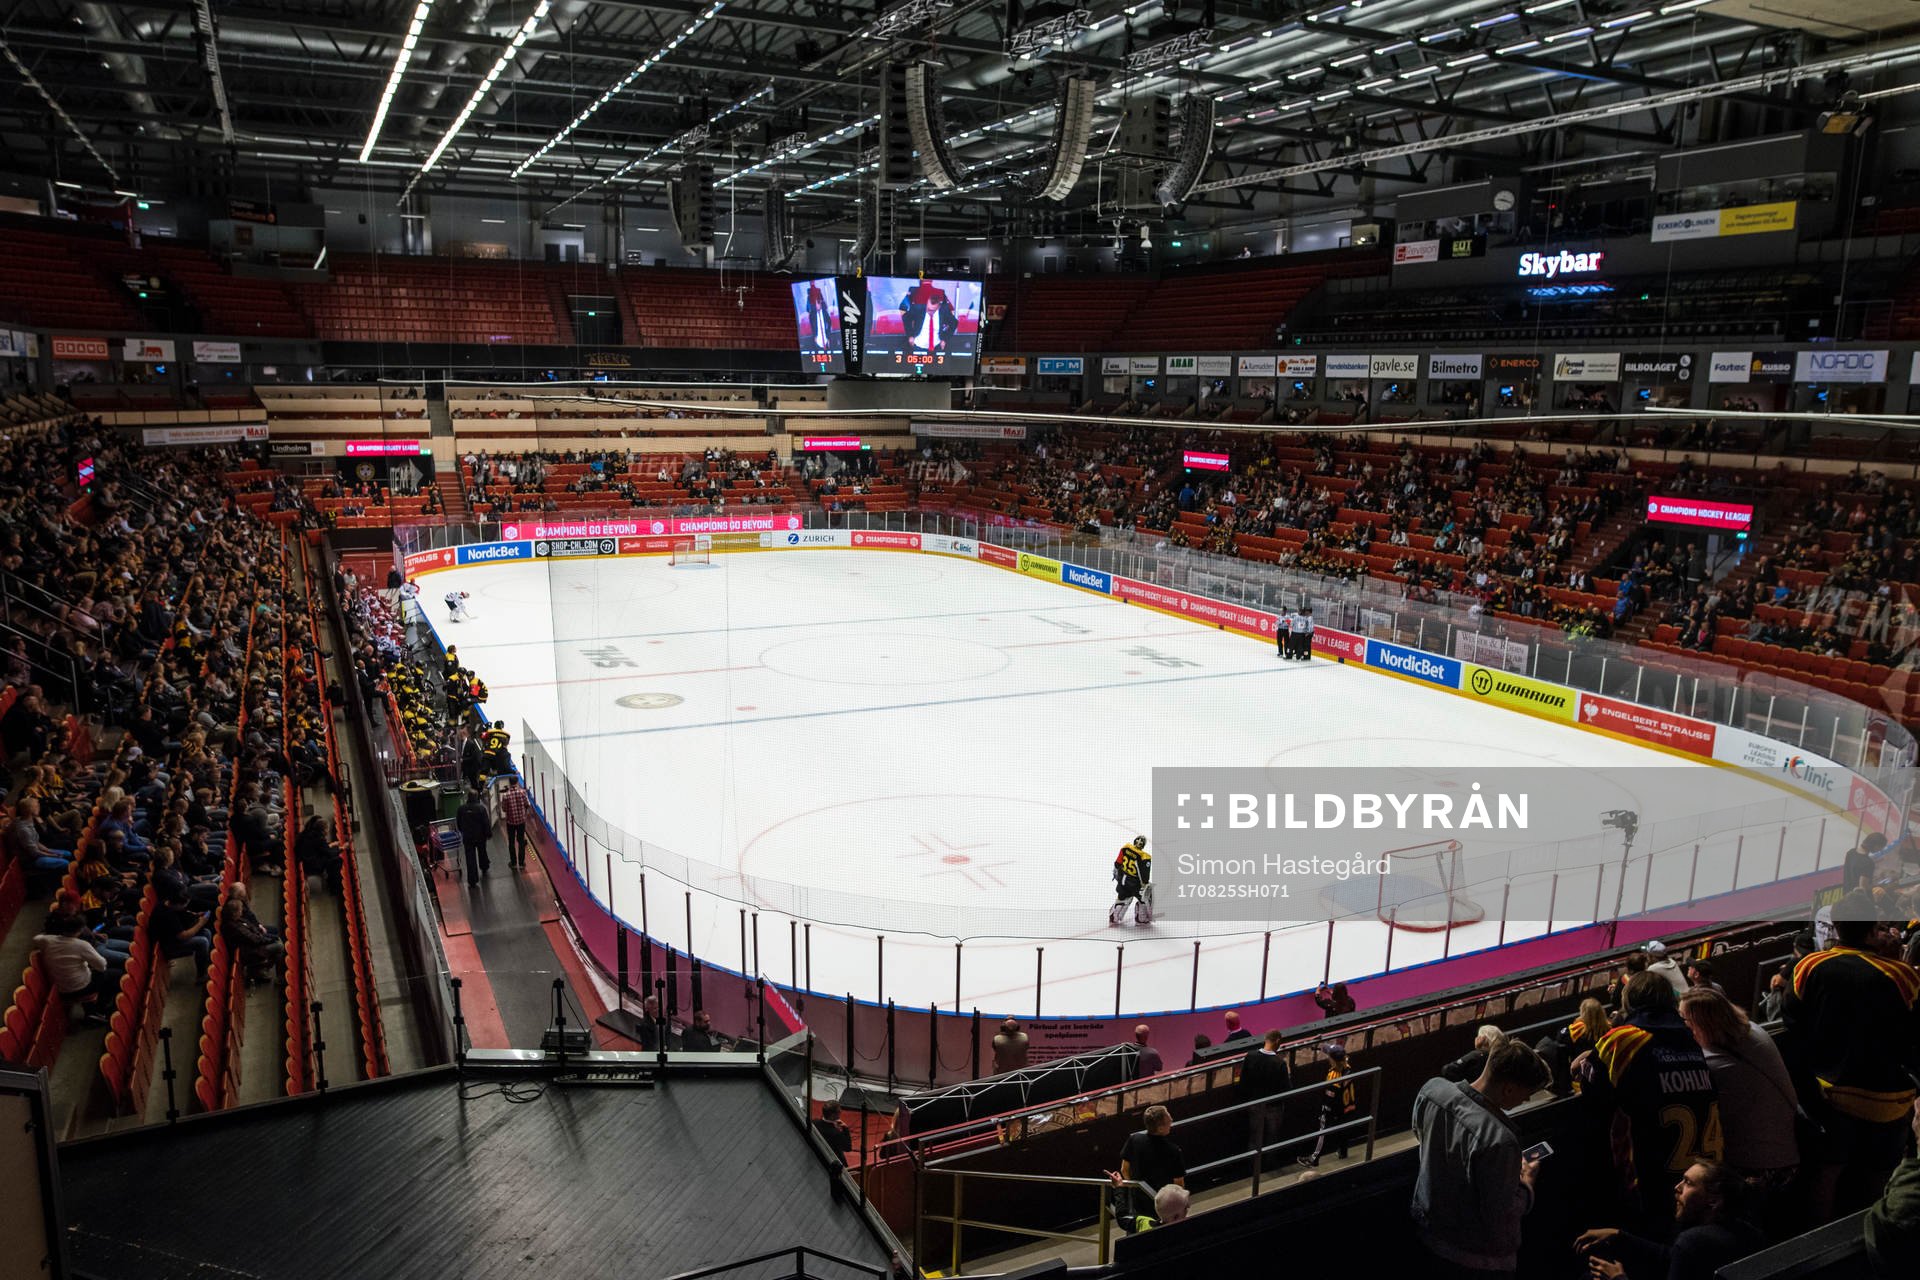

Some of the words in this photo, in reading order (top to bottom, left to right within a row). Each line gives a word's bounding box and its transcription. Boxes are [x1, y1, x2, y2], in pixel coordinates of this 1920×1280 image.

[1518, 250, 1602, 278] Skybar
[895, 355, 902, 363] 3
[907, 355, 933, 364] 05:00
[937, 356, 944, 364] 3
[1327, 362, 1368, 370] Handelsbanken
[1373, 358, 1415, 374] gavle.se
[1432, 360, 1478, 374] Bilmetro
[1501, 359, 1539, 368] ENERCO
[1810, 354, 1874, 369] NORDIC
[1625, 363, 1677, 372] BILBOLAGET
[1661, 505, 1697, 516] CHAMPIONS
[1698, 509, 1723, 519] HOCKEY
[1725, 512, 1751, 522] LEAGUE
[535, 524, 587, 537] CHAMPIONS
[589, 523, 600, 534] GO
[603, 522, 637, 534] BEYOND
[680, 521, 728, 532] CHAMPIONS
[729, 520, 740, 530] GO
[742, 518, 773, 529] BEYOND
[866, 535, 897, 544] CHAMPIONS
[468, 546, 520, 561] NordicBet
[1069, 569, 1103, 589] NordicBet
[1190, 602, 1217, 616] CHAMPIONS
[1218, 609, 1237, 621] HOCKEY
[1238, 614, 1257, 627] LEAGUE
[1327, 637, 1350, 651] LEAGUE
[1380, 648, 1445, 680] NordicBet
[1496, 681, 1566, 708] WARRIOR
[1601, 707, 1659, 729] ENGELBERT
[1660, 722, 1711, 741] STRAUSS
[1783, 756, 1834, 792] iClinic
[1658, 1100, 1725, 1171] 24
